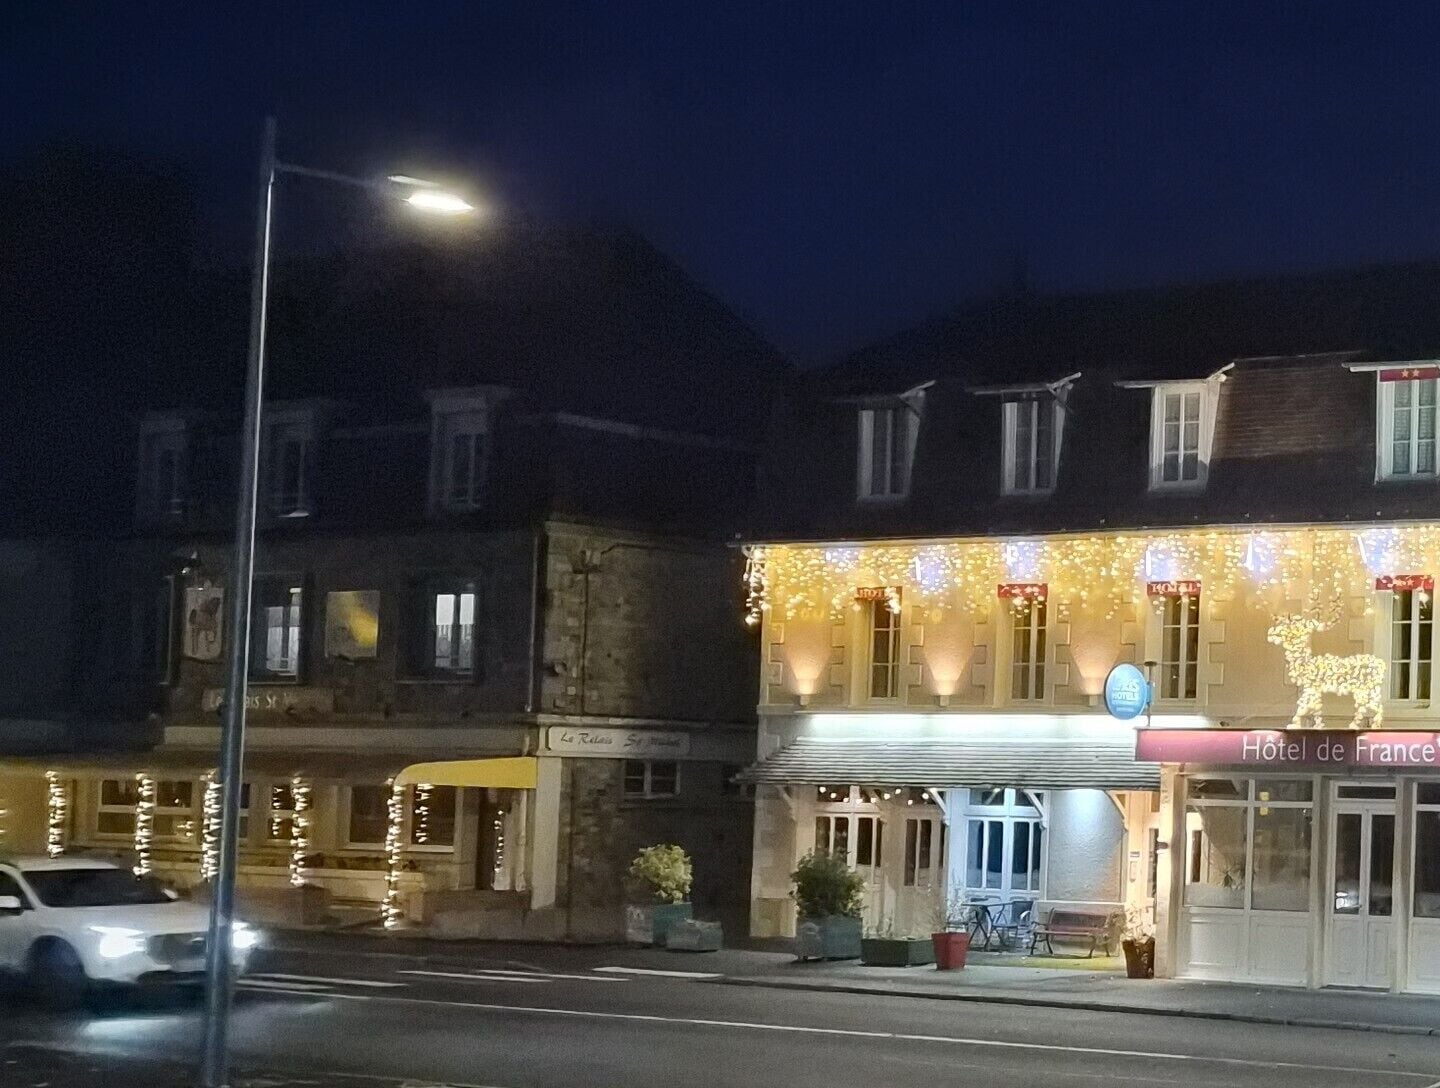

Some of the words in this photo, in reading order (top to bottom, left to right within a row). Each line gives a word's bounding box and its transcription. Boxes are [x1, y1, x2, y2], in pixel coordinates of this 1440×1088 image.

[560, 732, 574, 743] Le
[578, 732, 613, 745] Relais
[1242, 735, 1306, 761] Hôtel
[1317, 736, 1345, 762] de
[1356, 736, 1435, 762] France
